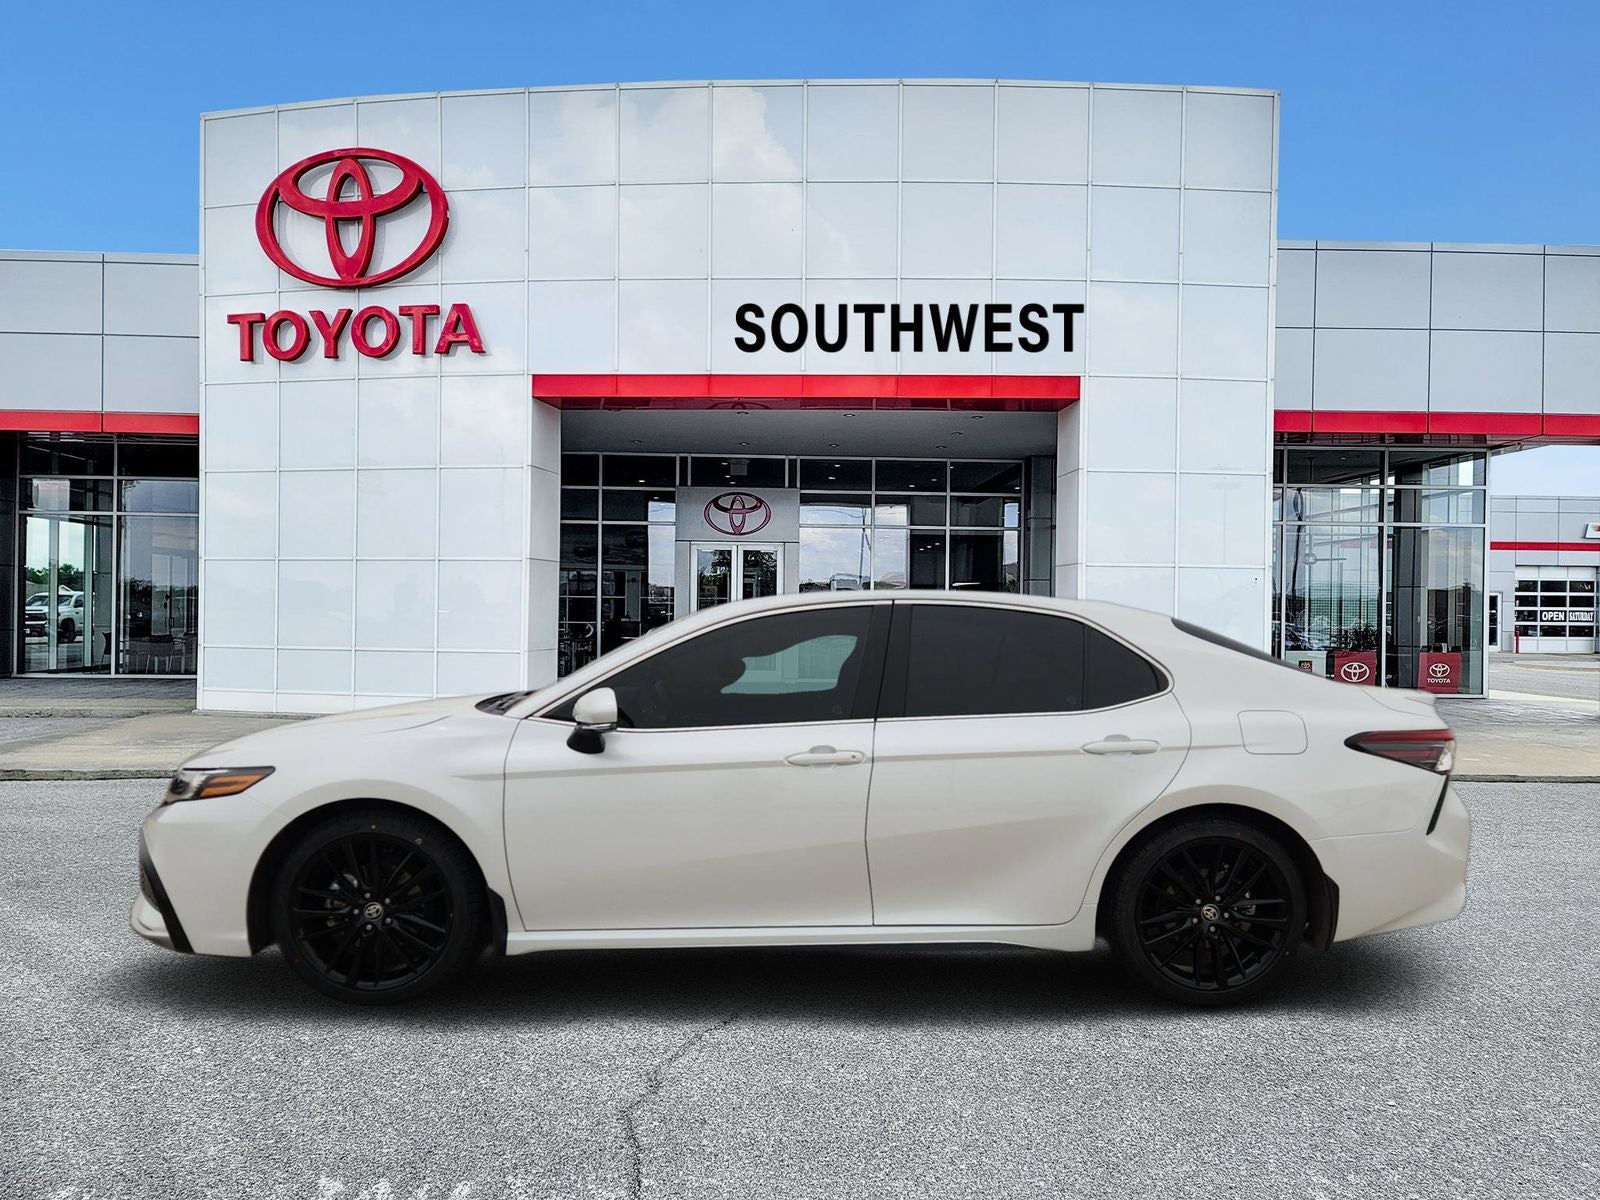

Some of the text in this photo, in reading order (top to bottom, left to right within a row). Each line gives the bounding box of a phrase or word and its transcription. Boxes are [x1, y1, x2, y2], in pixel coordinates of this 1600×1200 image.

[227, 303, 486, 361] TOYOTA
[734, 303, 1085, 353] SOUTHWEST
[1541, 611, 1594, 621] OPEN SATURDAY
